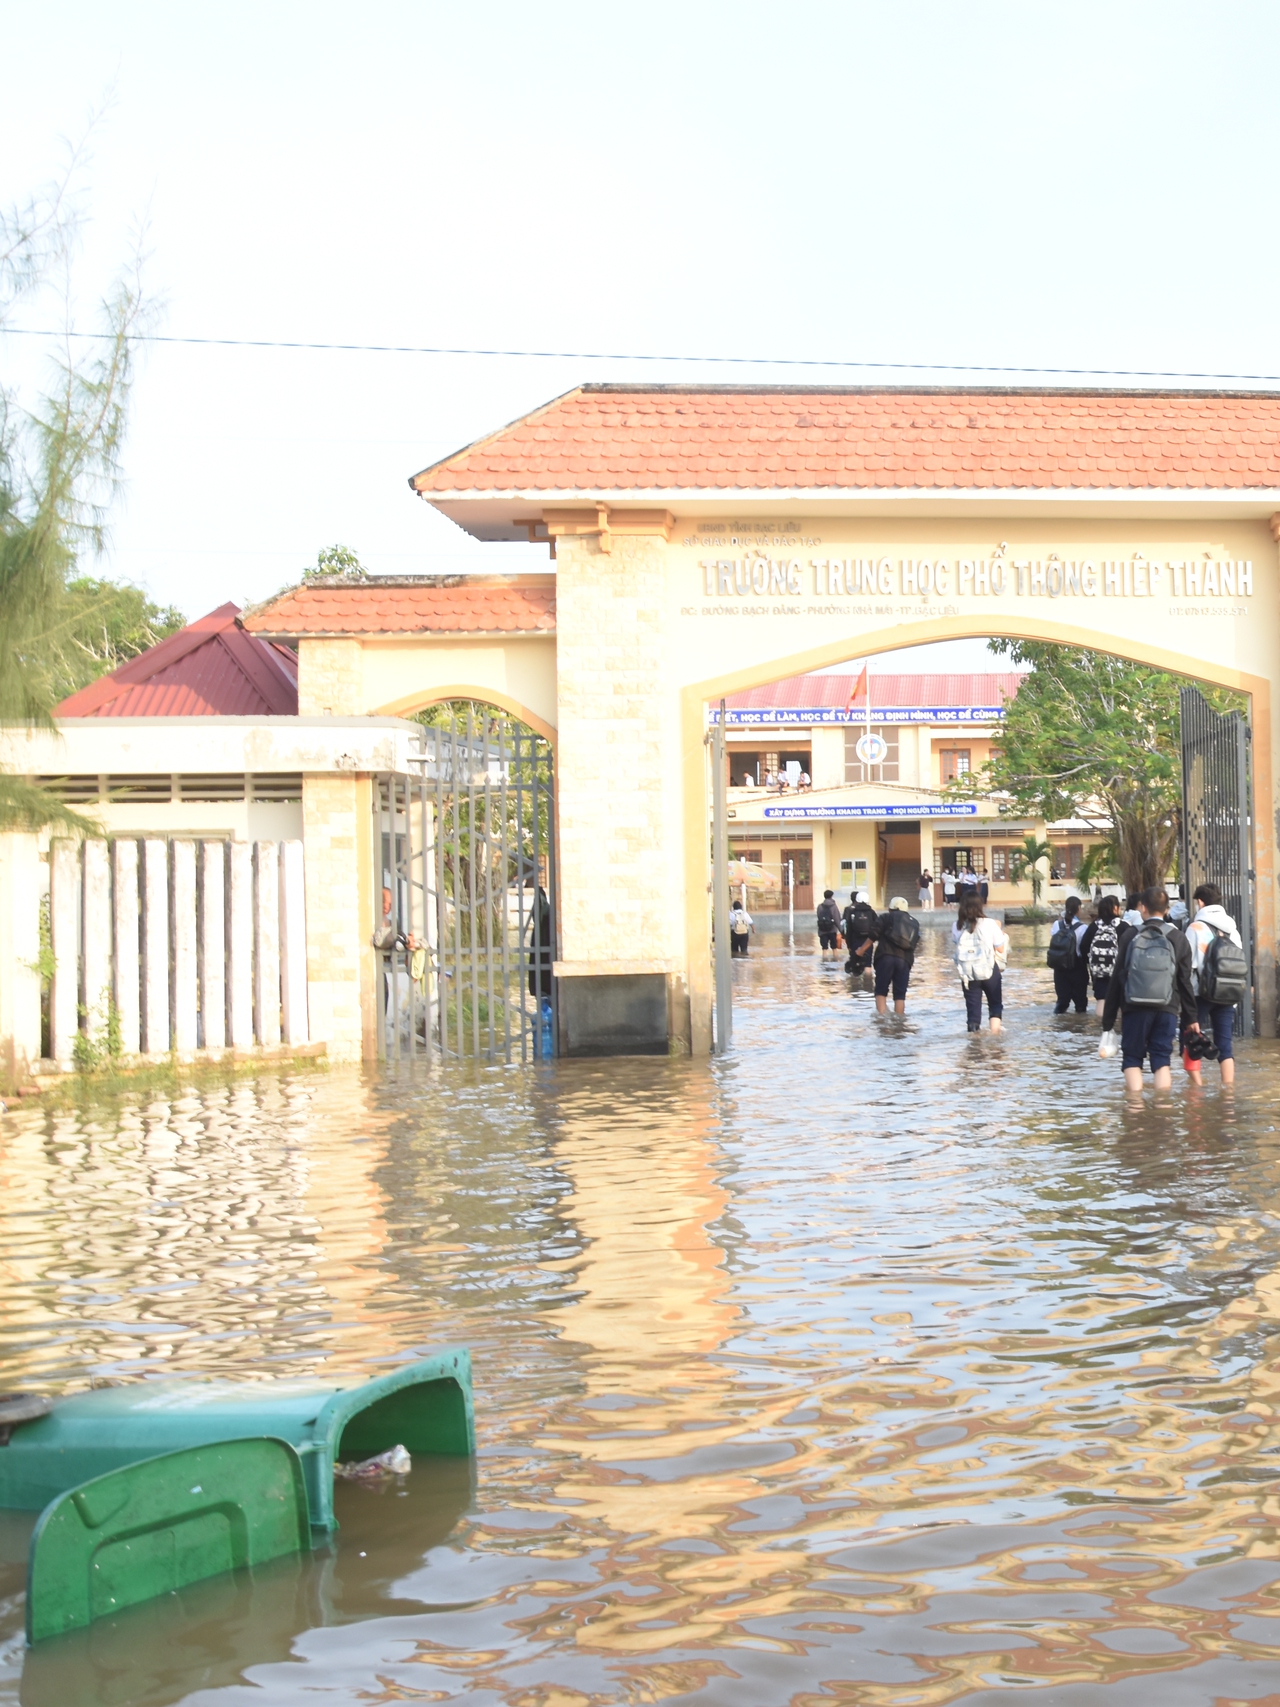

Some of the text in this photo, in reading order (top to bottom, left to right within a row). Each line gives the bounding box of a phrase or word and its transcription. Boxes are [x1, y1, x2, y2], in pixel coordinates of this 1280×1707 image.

[682, 535, 698, 547] SỞ
[701, 535, 728, 547] GIÁO
[731, 537, 752, 548] DỤC
[755, 534, 769, 547] VÀ
[800, 536, 822, 548] TẠO
[699, 550, 802, 596] TRƯỜNG
[809, 557, 893, 596] TRUNG
[899, 558, 950, 604] HỌC
[957, 541, 1009, 596] PHỔ
[1013, 553, 1097, 598] THÔNG
[1167, 552, 1253, 597] THÀNH
[741, 713, 761, 724] HỌC
[762, 710, 776, 721] ĐỂ
[800, 712, 821, 723] HỌC
[822, 709, 836, 721] ĐỂ
[885, 711, 909, 722] ĐỊNH
[910, 710, 936, 721] MÌNH,
[937, 711, 957, 721] HỌC
[958, 708, 972, 719] ĐỂ
[973, 709, 999, 719] CÙNG
[769, 808, 783, 816] XÂY
[784, 808, 805, 817] DỰNG
[805, 807, 835, 816] TRƯỜNG
[892, 808, 906, 816] MỌI
[907, 806, 930, 815] NGƯỜI
[931, 806, 950, 814] THÂN
[951, 806, 972, 815] THIỆN
